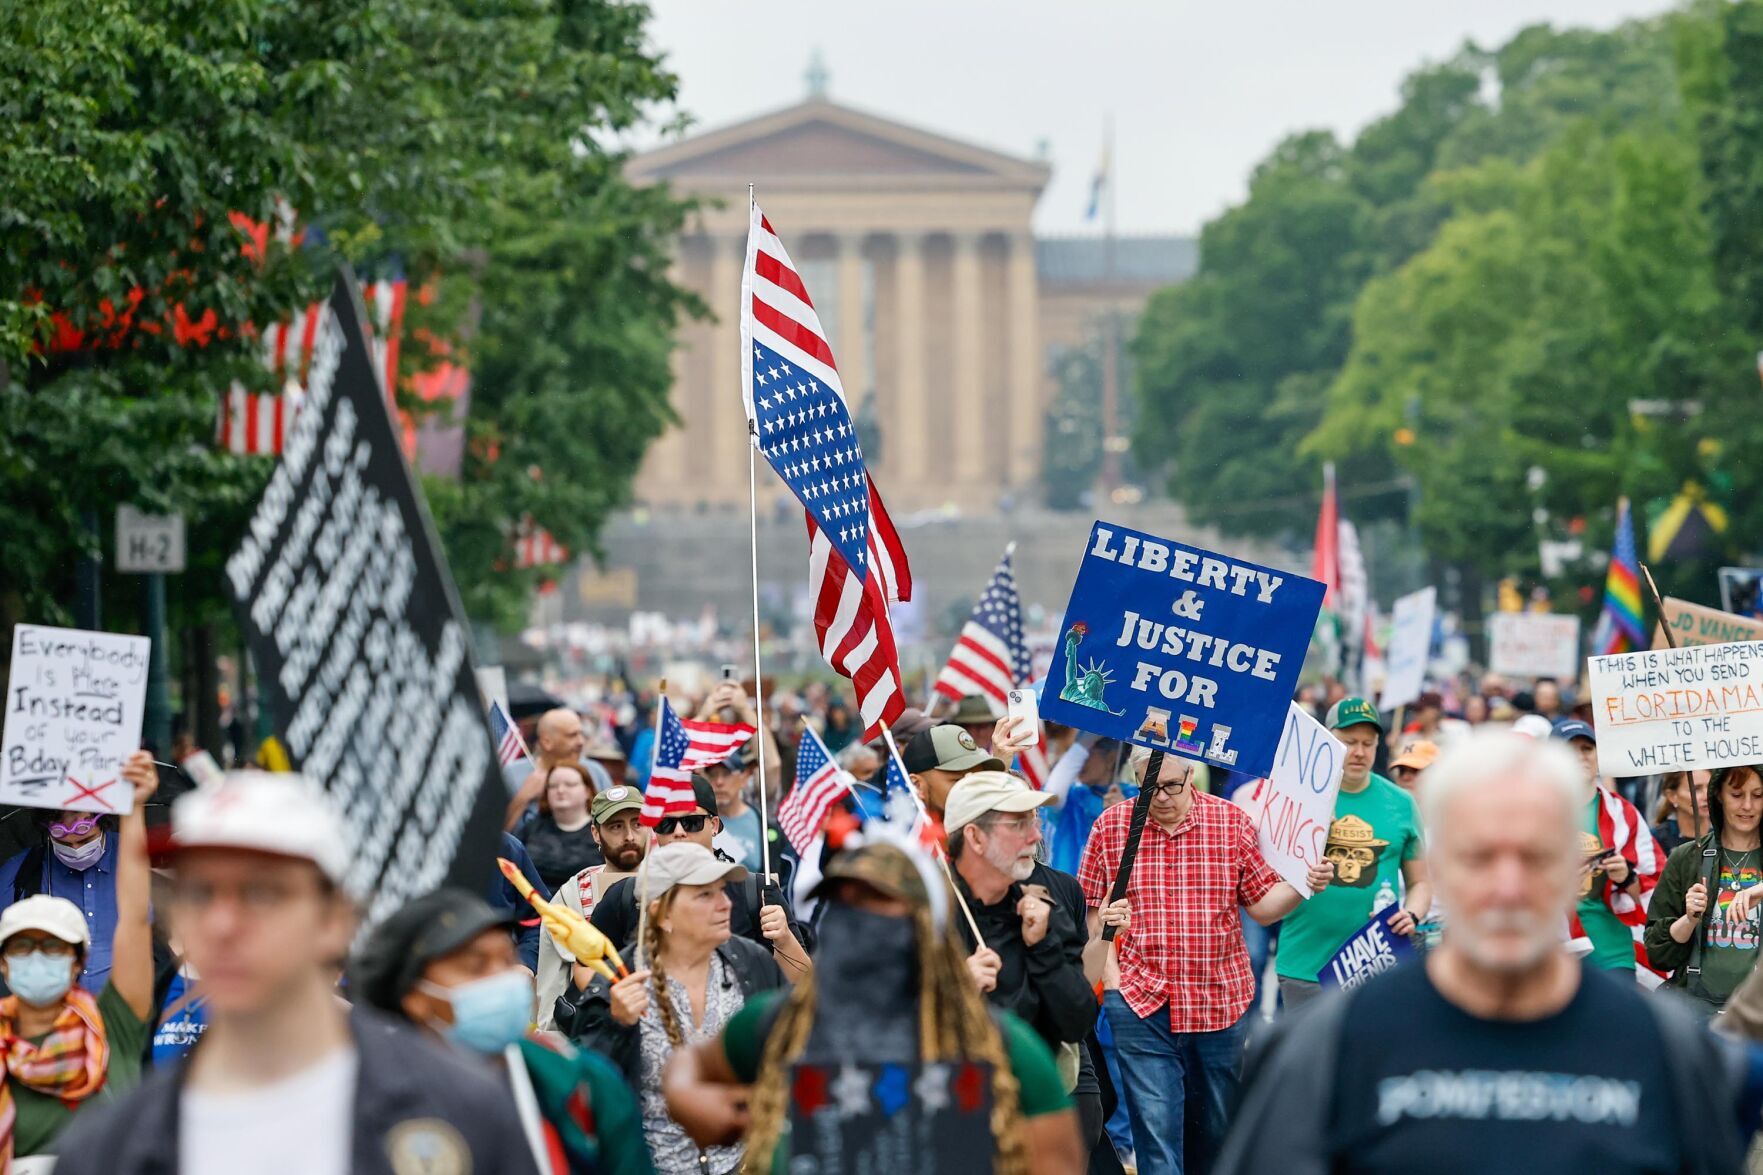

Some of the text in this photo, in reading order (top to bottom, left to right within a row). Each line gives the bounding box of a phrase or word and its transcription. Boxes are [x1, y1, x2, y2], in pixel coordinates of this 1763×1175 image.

[128, 533, 172, 566] H-2
[1091, 527, 1284, 604] LIBERTY
[1172, 590, 1205, 621] &
[1670, 611, 1694, 632] JD
[19, 630, 144, 684] Everybody
[1116, 610, 1282, 682] JUSTICE
[1595, 656, 1636, 673] THIS
[1643, 653, 1658, 669] IS
[1665, 648, 1701, 667] WHAT
[1130, 661, 1219, 709] FOR
[1622, 662, 1750, 689] WHEN YOU SEND
[14, 686, 123, 726] Instead
[1721, 683, 1763, 710] MA
[1132, 705, 1239, 766] ALL
[1672, 716, 1731, 737] TO THE
[9, 744, 70, 785] Bday
[1281, 713, 1334, 794] NO
[1628, 735, 1763, 768] WHITE HOUSE
[1258, 778, 1326, 868] KINGS
[1335, 828, 1373, 839] RESIST
[1332, 919, 1390, 987] I HAVE
